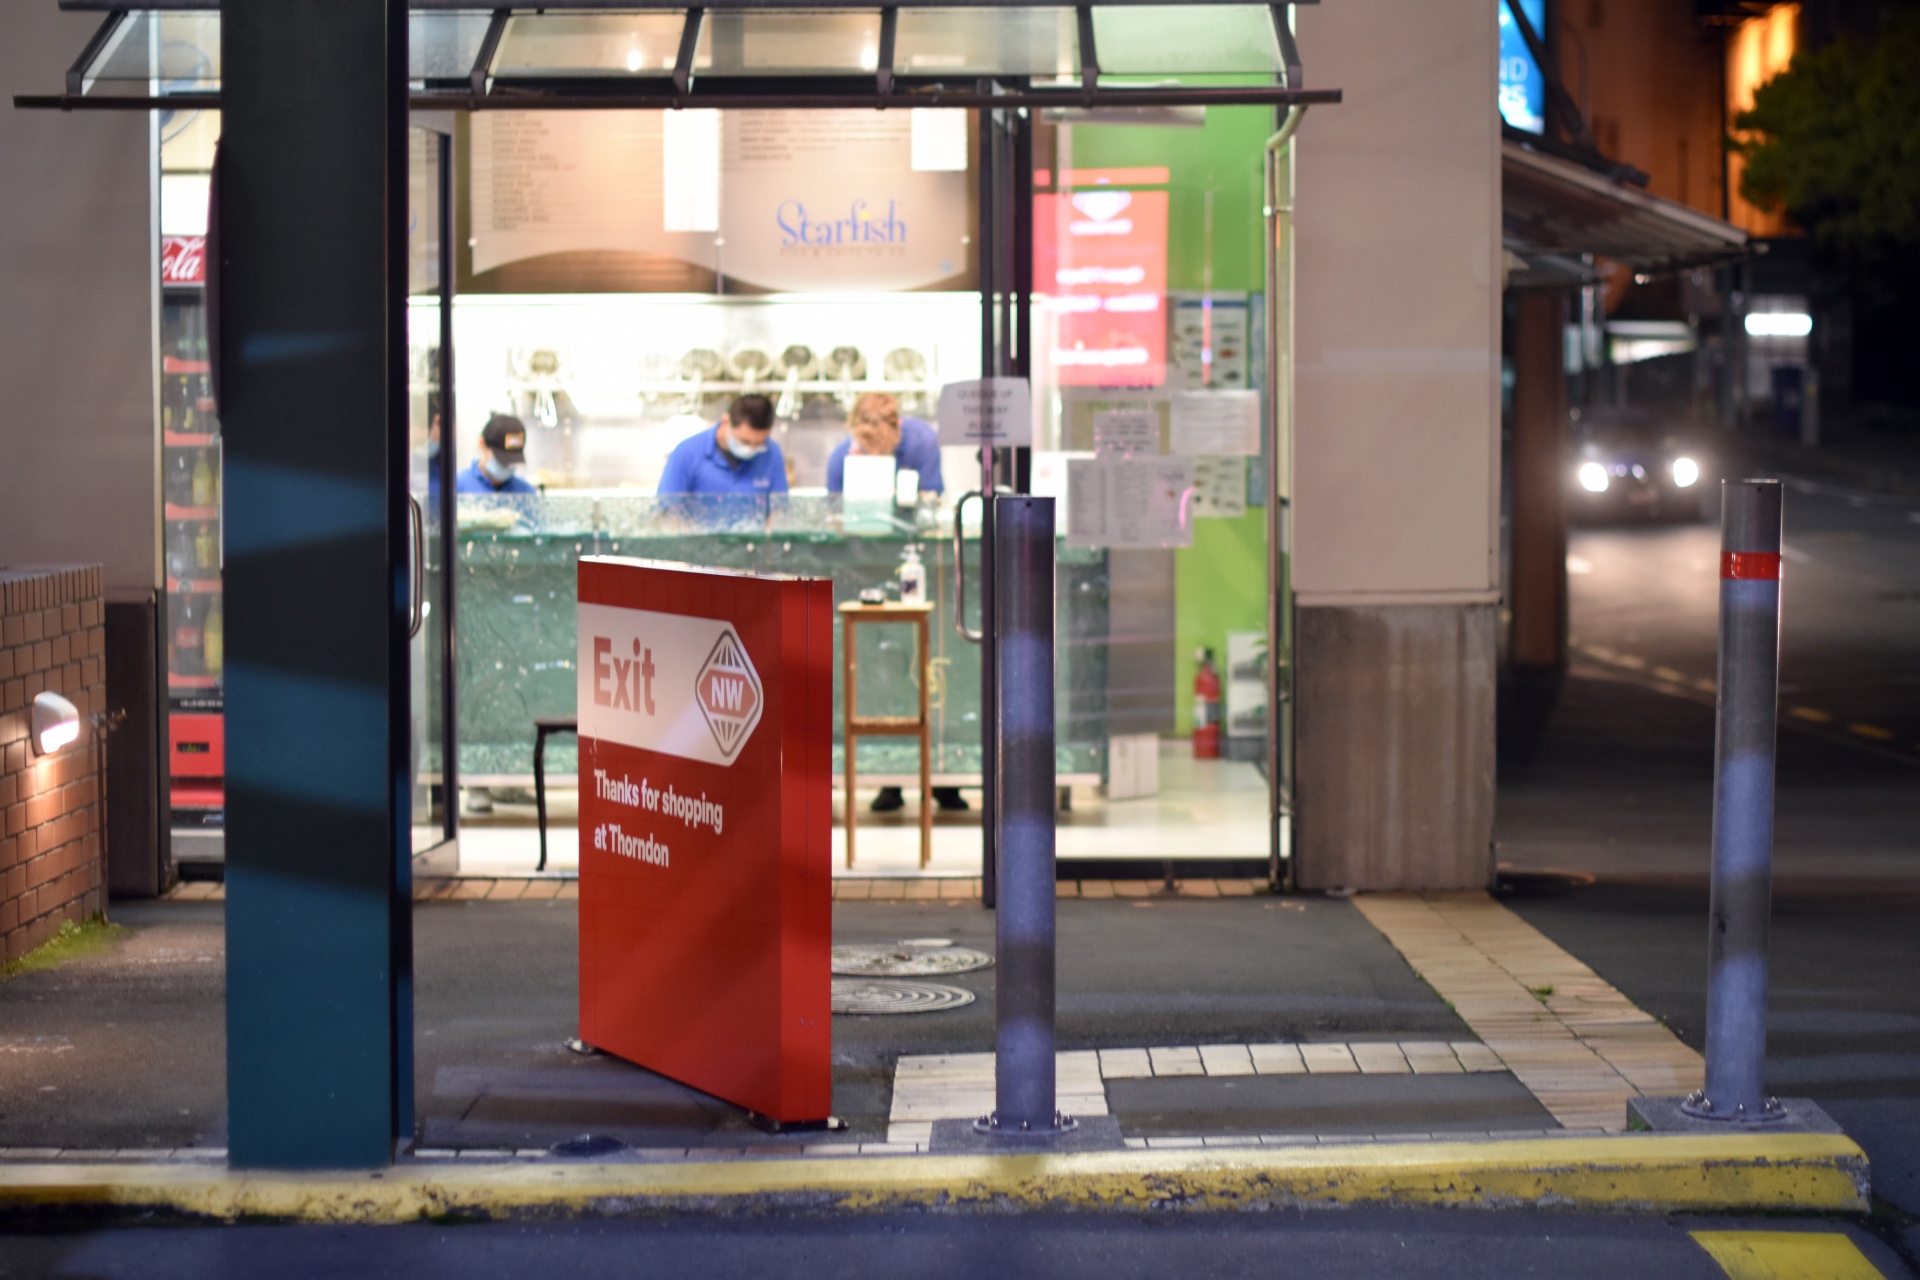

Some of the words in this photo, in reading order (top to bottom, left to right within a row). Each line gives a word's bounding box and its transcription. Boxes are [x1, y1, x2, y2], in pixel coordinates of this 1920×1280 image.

[776, 199, 906, 247] Starfish
[963, 405, 984, 415] THIS
[986, 405, 1008, 415] WAY
[969, 421, 1002, 430] PLEASE
[594, 636, 655, 716] Exit
[711, 676, 744, 711] NW
[594, 768, 640, 807] Thanks
[641, 777, 660, 812] for
[662, 784, 723, 835] shopping
[594, 823, 607, 851] at
[609, 823, 669, 868] Thorndon
